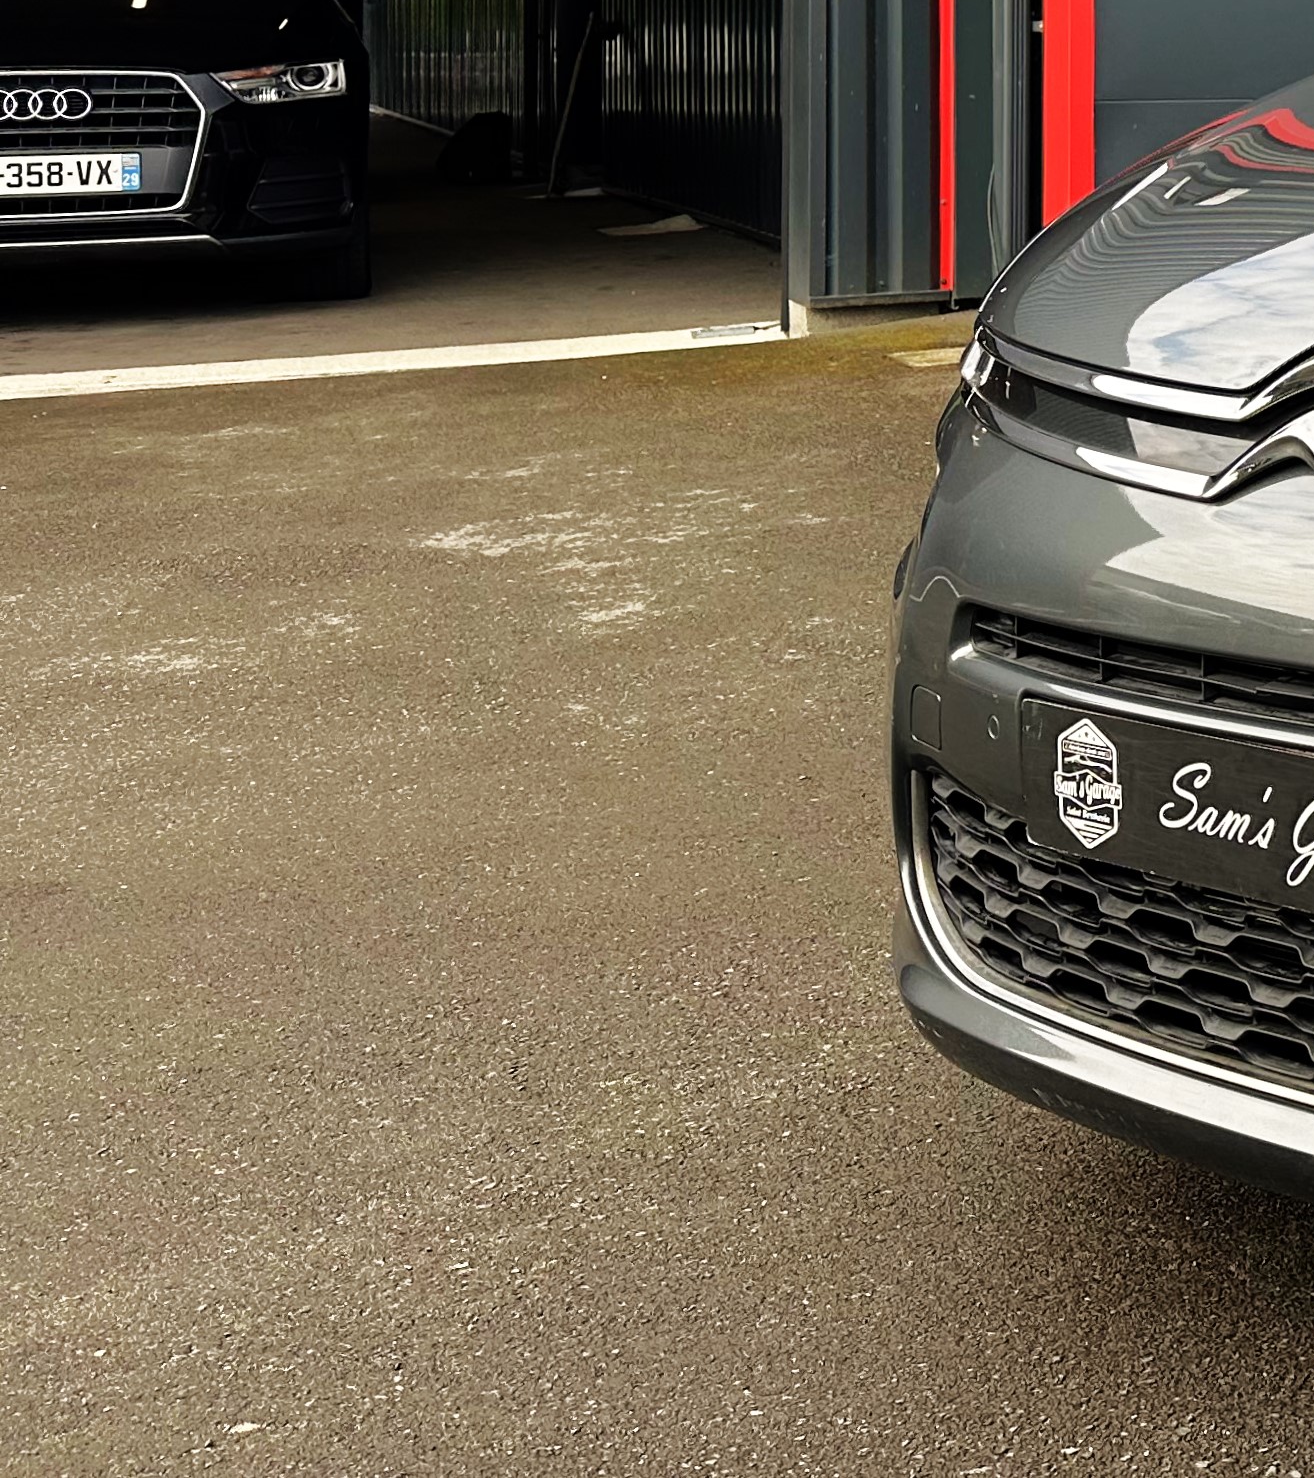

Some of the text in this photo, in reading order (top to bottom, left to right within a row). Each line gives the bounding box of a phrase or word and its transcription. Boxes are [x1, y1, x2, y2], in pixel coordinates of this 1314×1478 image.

[122, 173, 139, 187] 29
[1085, 774, 1120, 805] Garage
[1159, 761, 1276, 849] Sam's
